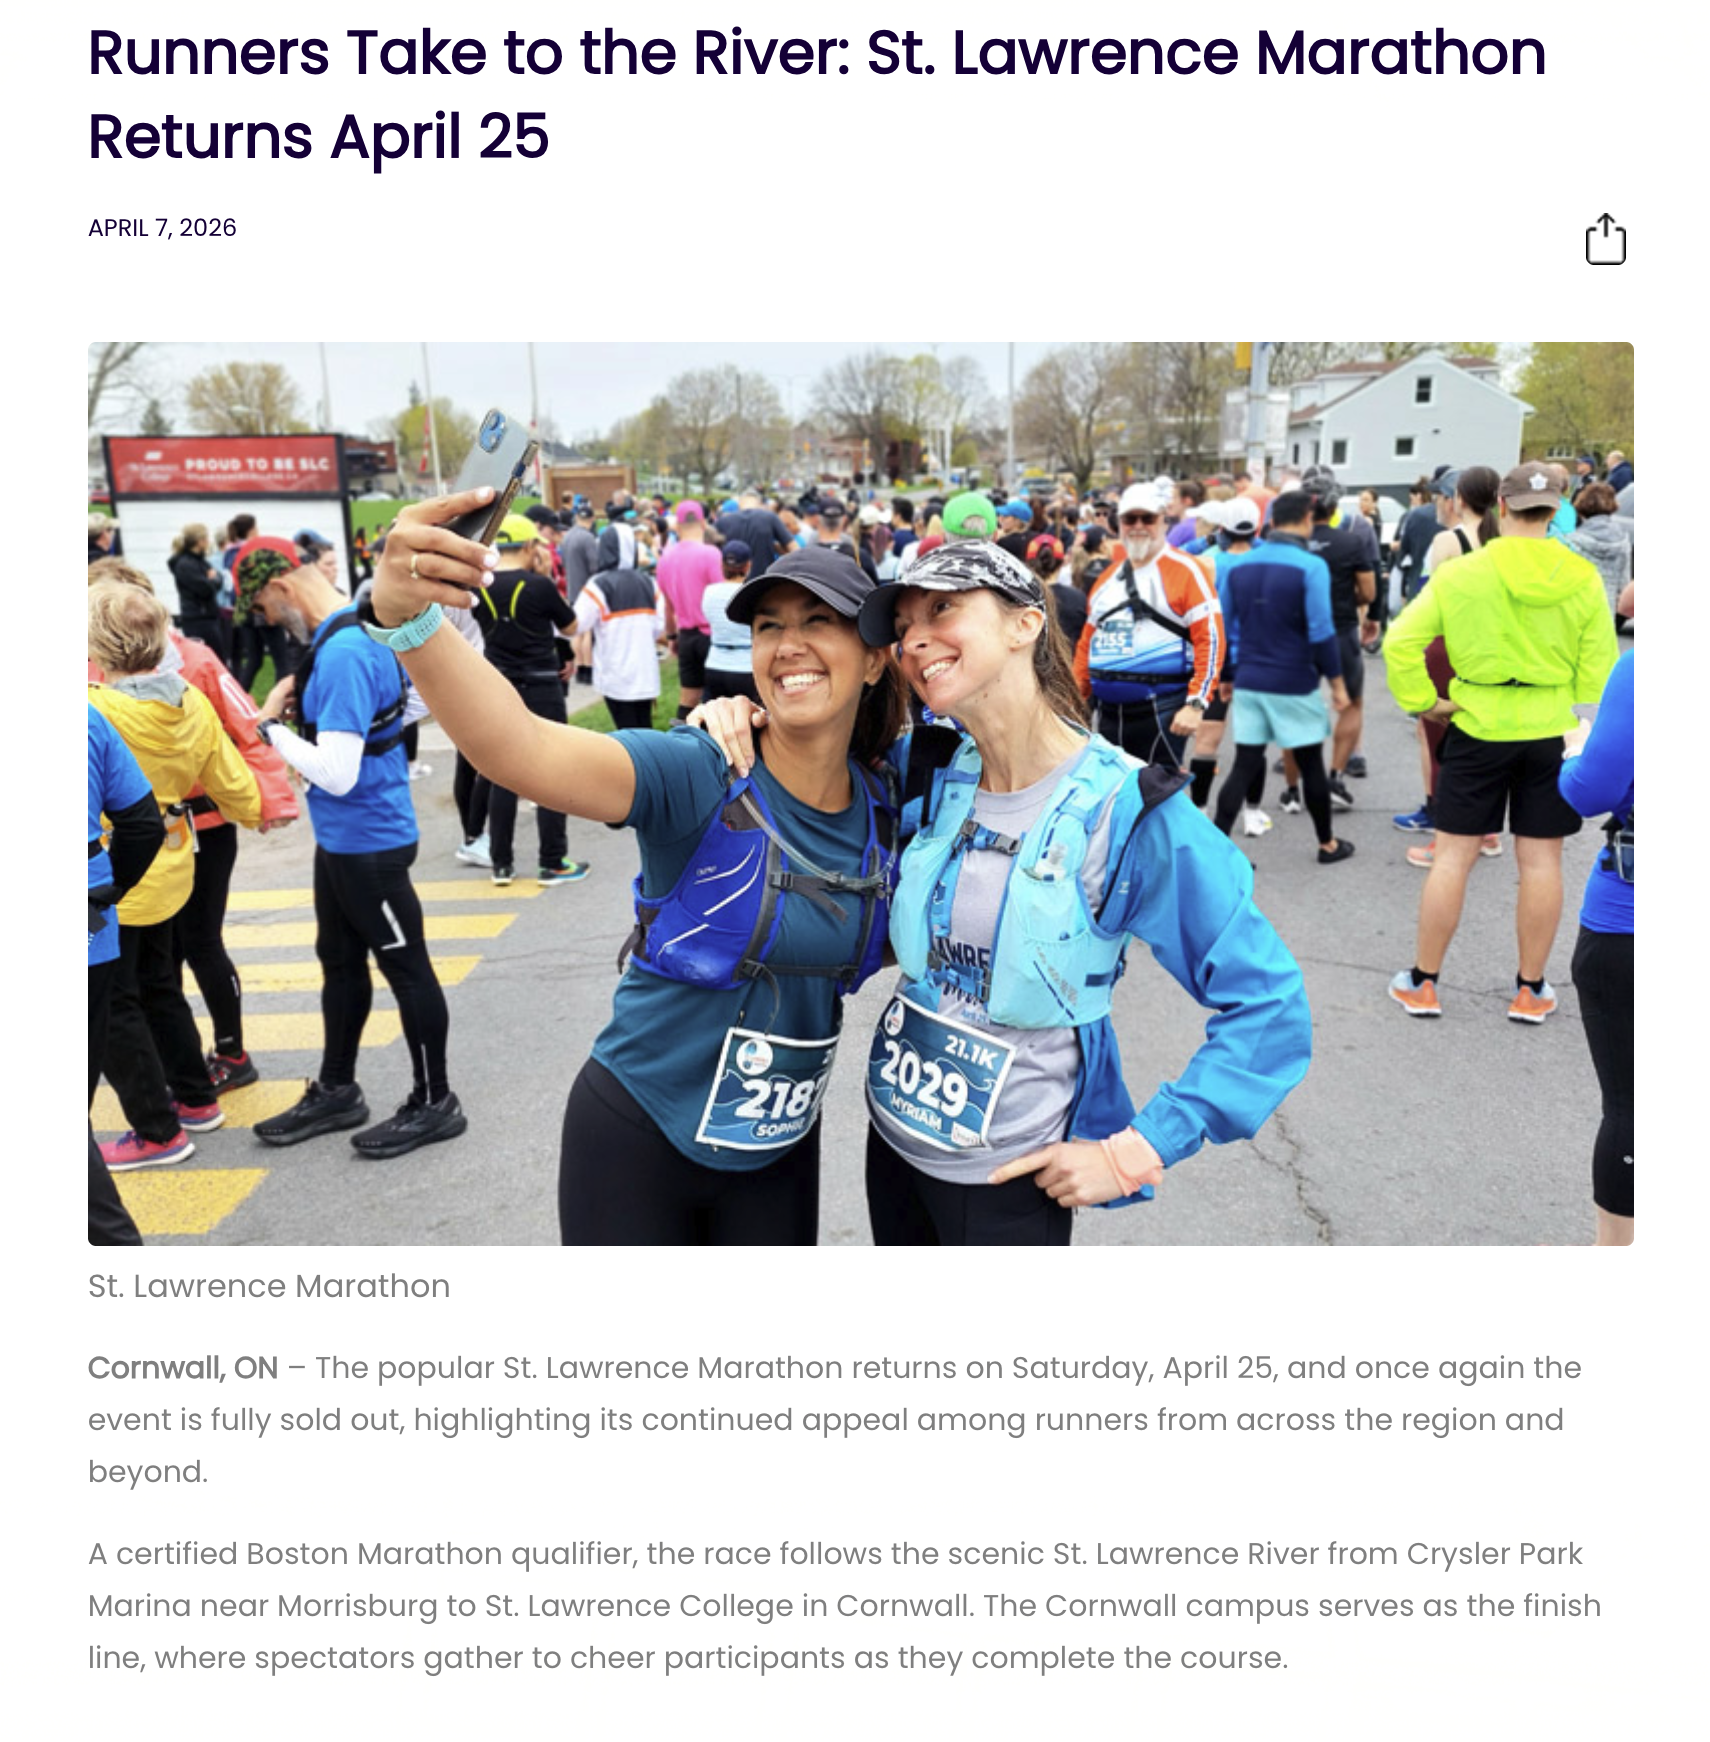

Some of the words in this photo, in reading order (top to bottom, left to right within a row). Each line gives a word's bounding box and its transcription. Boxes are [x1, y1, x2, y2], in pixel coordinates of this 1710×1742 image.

[90, 29, 329, 76] Runners
[346, 26, 487, 76] Take
[503, 30, 563, 76] to
[579, 26, 677, 76] the
[695, 25, 850, 76] River:
[868, 28, 936, 76] St.
[954, 29, 1239, 76] Lawrence
[1258, 26, 1546, 76] Marathon
[90, 113, 313, 160] Returns
[329, 109, 460, 175] April
[479, 111, 549, 159] 25
[87, 218, 149, 237] APRIL
[154, 217, 173, 241] 7,
[179, 217, 237, 237] 2026
[184, 457, 242, 472] PROUD
[245, 457, 269, 471] TO
[273, 457, 295, 471] BE
[298, 457, 331, 471] SLC
[933, 936, 991, 969] AWRE
[944, 1034, 999, 1070] 21.1K
[880, 1040, 969, 1118] 2029
[890, 1092, 943, 1131] MYRIAM
[88, 1273, 124, 1298] St.
[135, 1274, 286, 1298] Lawrence
[296, 1272, 450, 1298] Marathon
[87, 1354, 227, 1384] Cornwall,
[234, 1355, 278, 1380] ON
[315, 1355, 369, 1379] The
[378, 1355, 495, 1387] popular
[503, 1356, 538, 1379] St.
[547, 1356, 689, 1379] Lawrence
[698, 1355, 842, 1379] Marathon
[853, 1356, 957, 1379] returns
[966, 1360, 1003, 1379] on
[1012, 1355, 1155, 1387] Saturday,
[1162, 1354, 1228, 1387] April
[1237, 1355, 1279, 1383] 25,
[1287, 1355, 1346, 1379] and
[1355, 1360, 1430, 1379] once
[1438, 1354, 1524, 1387] again
[1533, 1355, 1582, 1379] the
[88, 1408, 172, 1431] event
[181, 1406, 202, 1431] is
[210, 1406, 272, 1439] fully
[280, 1407, 341, 1431] sold
[350, 1408, 406, 1435] out,
[415, 1406, 590, 1439] highlighting
[600, 1406, 633, 1431] its
[642, 1406, 792, 1431] continued
[802, 1407, 908, 1439] appeal
[917, 1412, 1025, 1439] among
[1036, 1412, 1148, 1431] runners
[1157, 1406, 1227, 1431] from
[1236, 1412, 1336, 1431] across
[1344, 1407, 1393, 1431] the
[1402, 1406, 1496, 1439] region
[1505, 1407, 1563, 1431] and
[89, 1459, 208, 1491] beyond.
[88, 1542, 108, 1565] A
[116, 1540, 237, 1565] certified
[247, 1542, 348, 1565] Boston
[358, 1541, 502, 1565] Marathon
[511, 1540, 639, 1573] qualifier,
[646, 1541, 695, 1565] the
[704, 1546, 771, 1565] race
[779, 1540, 882, 1565] follows
[890, 1541, 939, 1565] the
[948, 1540, 1045, 1565] scenic
[1053, 1542, 1088, 1565] St.
[1097, 1542, 1239, 1565] Lawrence
[1248, 1540, 1320, 1565] River
[1327, 1540, 1398, 1565] from
[1407, 1541, 1511, 1573] Crysler
[1520, 1541, 1584, 1565] Park
[89, 1592, 191, 1617] Marina
[201, 1598, 270, 1617] near
[278, 1592, 437, 1625] Morrisburg
[446, 1594, 477, 1617] to
[485, 1594, 519, 1617] St.
[529, 1594, 671, 1617] Lawrence
[679, 1593, 794, 1625] College
[803, 1592, 827, 1617] in
[836, 1593, 975, 1617] Cornwall.
[983, 1593, 1037, 1617] The
[1045, 1593, 1176, 1617] Cornwall
[1186, 1598, 1309, 1625] campus
[1318, 1598, 1414, 1617] serves
[1423, 1598, 1458, 1617] as
[1466, 1593, 1515, 1617] the
[1523, 1592, 1601, 1617] finish
[89, 1644, 146, 1673] line,
[154, 1645, 246, 1669] where
[255, 1646, 415, 1677] spectators
[423, 1645, 524, 1677] gather
[531, 1646, 562, 1669] to
[570, 1645, 656, 1669] cheer
[665, 1644, 845, 1677] participants
[854, 1650, 889, 1669] as
[897, 1645, 964, 1677] they
[971, 1645, 1115, 1677] complete
[1123, 1645, 1172, 1669] the
[1180, 1650, 1288, 1669] course.
